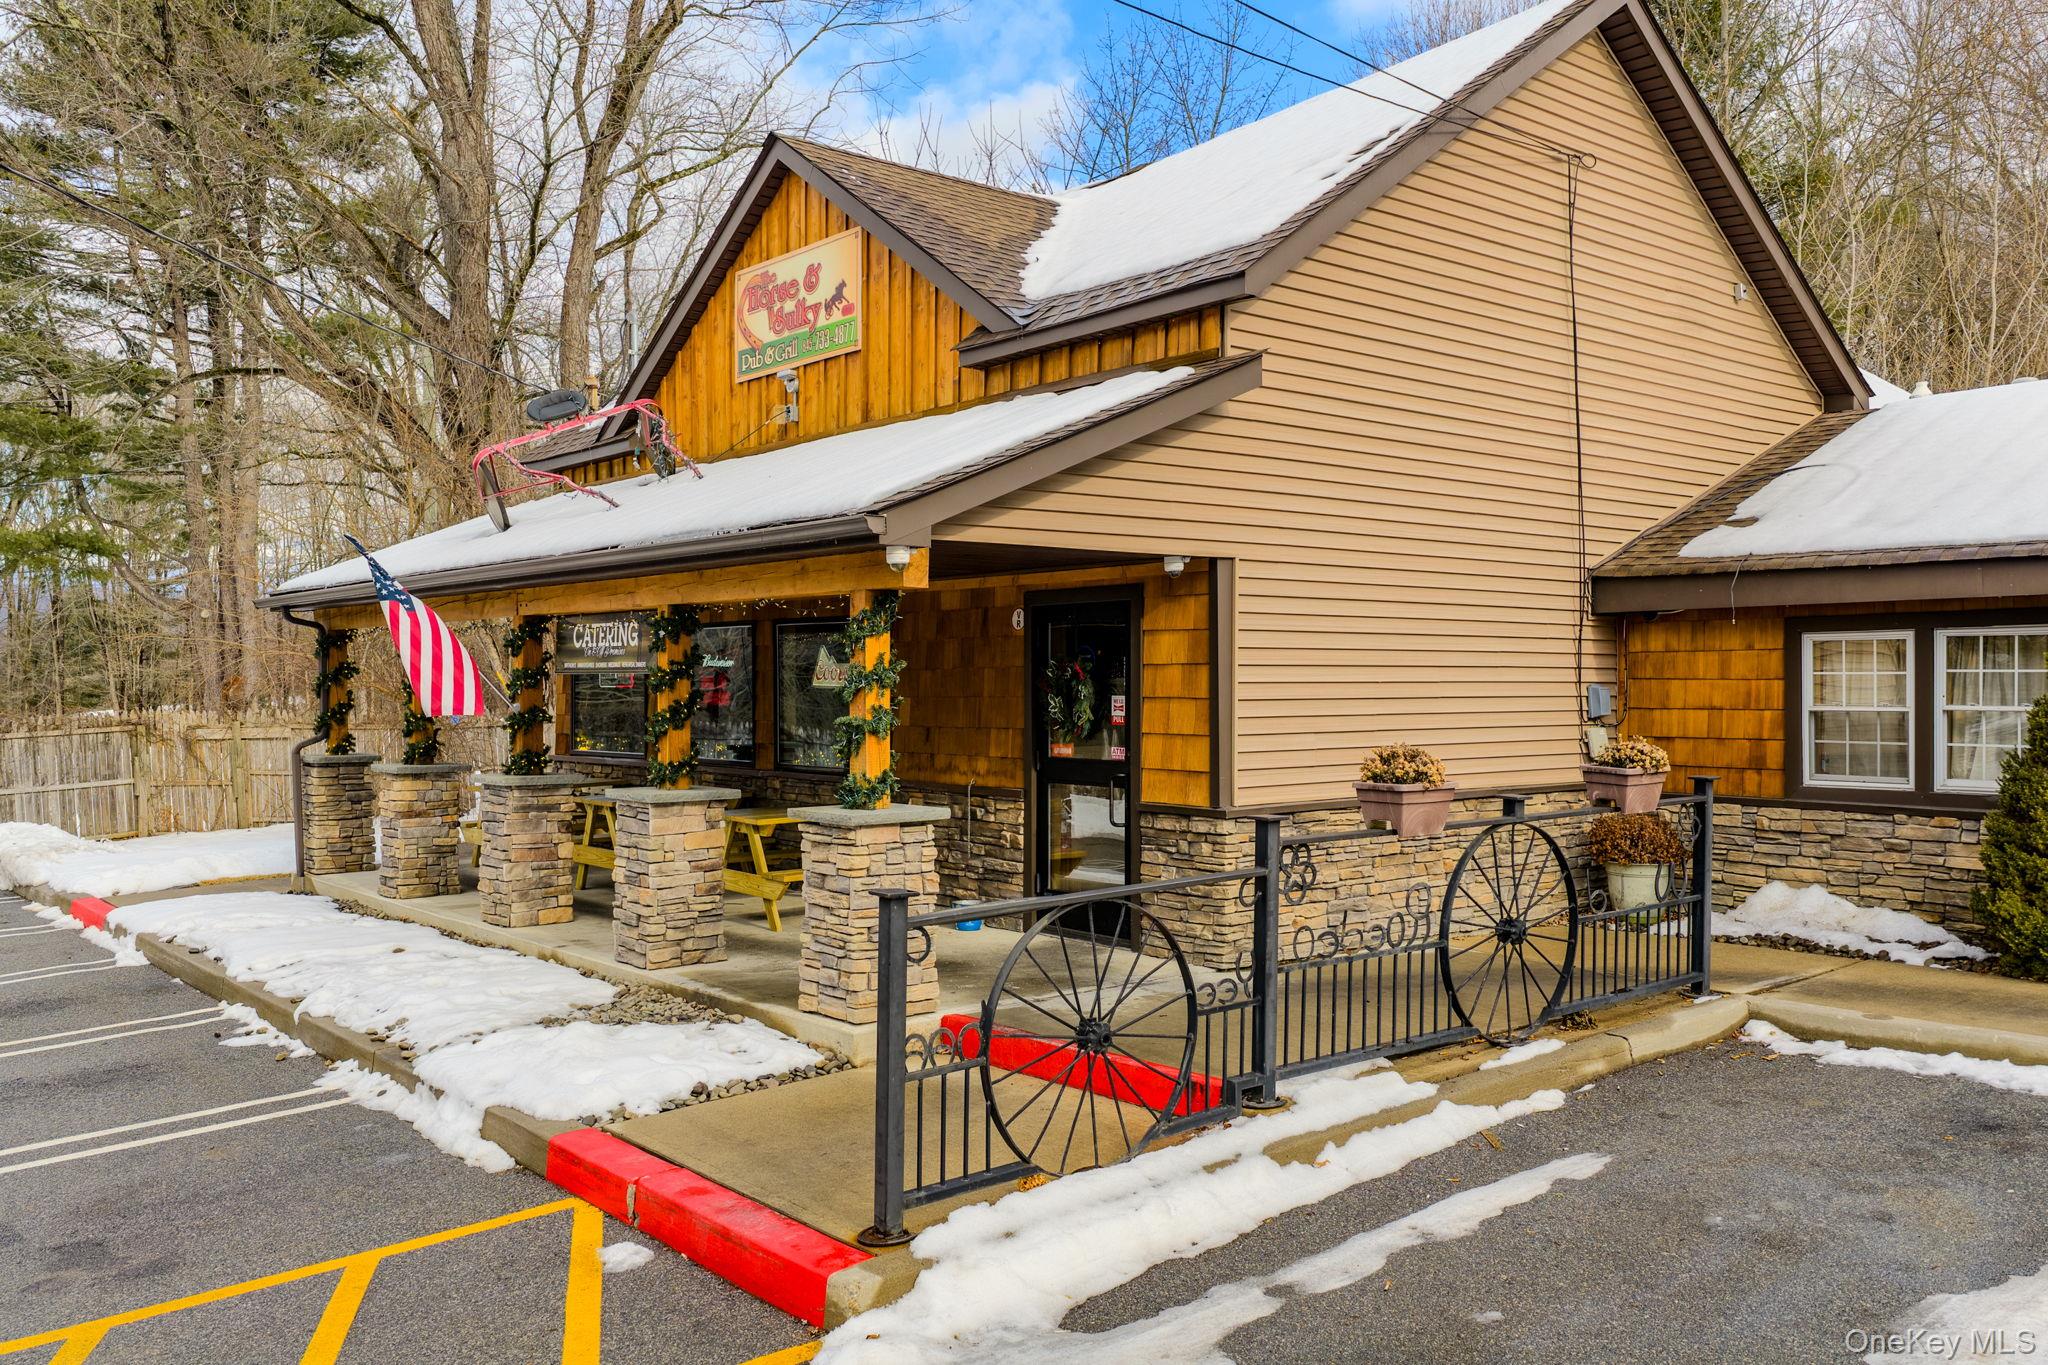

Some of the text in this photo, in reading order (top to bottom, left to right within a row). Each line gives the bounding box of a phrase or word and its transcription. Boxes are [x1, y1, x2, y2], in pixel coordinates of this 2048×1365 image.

[747, 279, 800, 315] Horse
[768, 297, 823, 338] Sulky
[741, 350, 764, 372] Pub
[775, 337, 799, 361] Grill
[573, 620, 640, 648] CATERING
